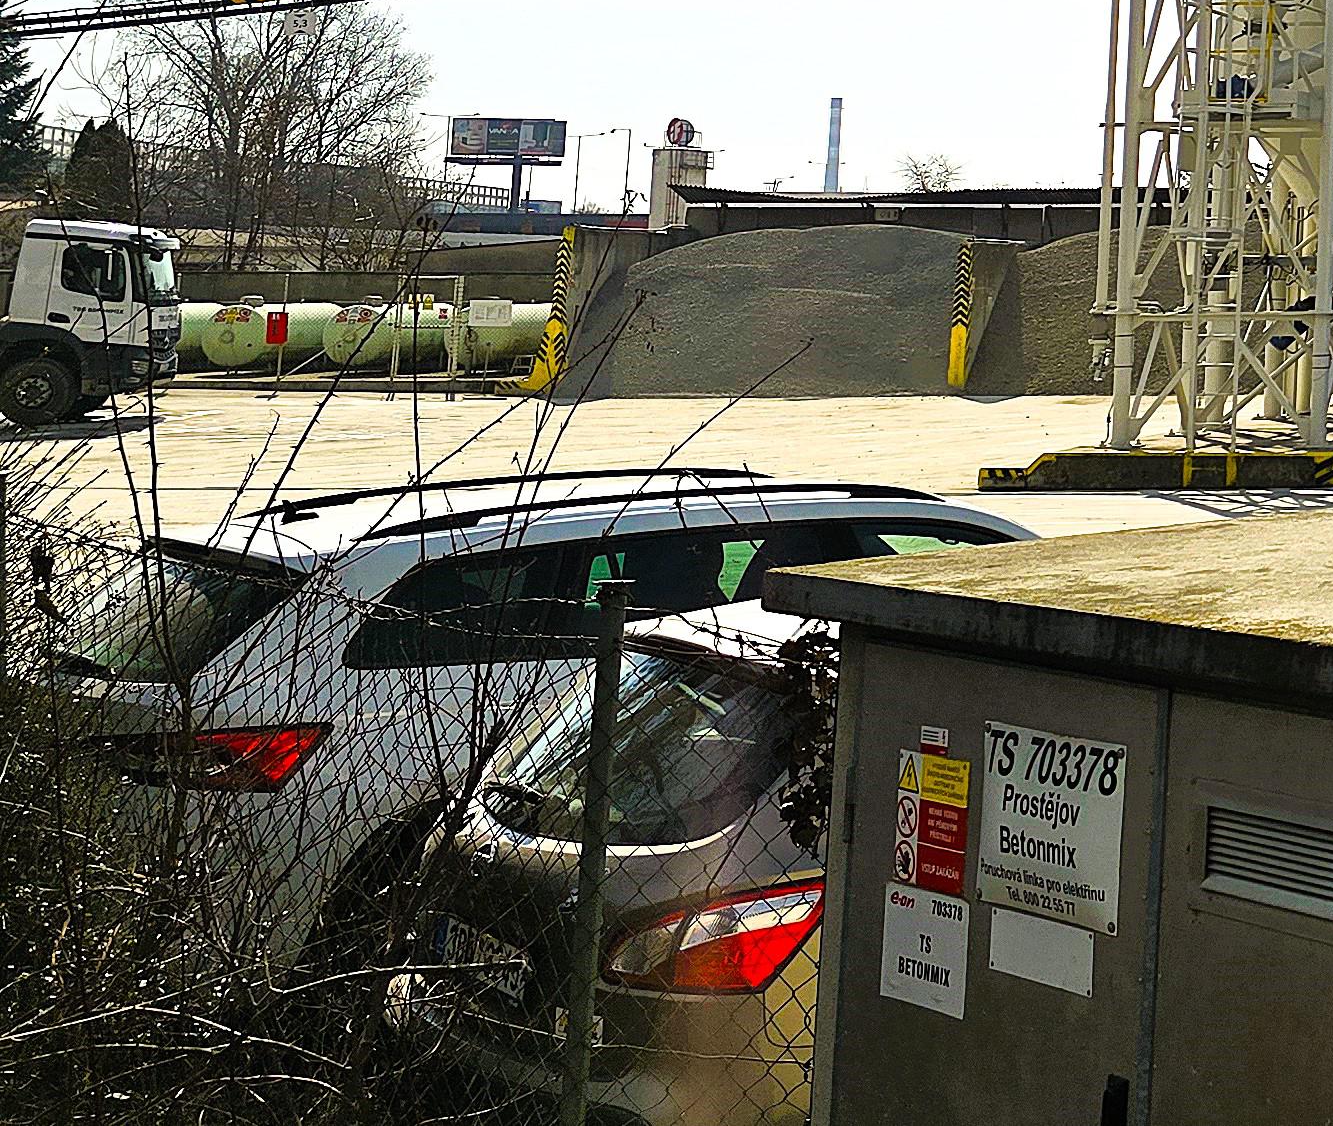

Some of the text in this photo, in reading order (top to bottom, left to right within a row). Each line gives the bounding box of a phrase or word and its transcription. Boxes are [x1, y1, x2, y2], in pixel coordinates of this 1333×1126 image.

[989, 729, 1019, 777] TS
[1024, 736, 1120, 796] 703378
[1002, 783, 1081, 830] Prostějov
[999, 824, 1077, 869] Betonmix
[980, 857, 1105, 902] Poruchová linka pro elektřinu
[1005, 885, 1022, 903] Tel.
[1023, 890, 1039, 907] 800
[931, 899, 963, 922] 703378
[919, 934, 932, 954] TS
[897, 955, 951, 987] BETONMIX
